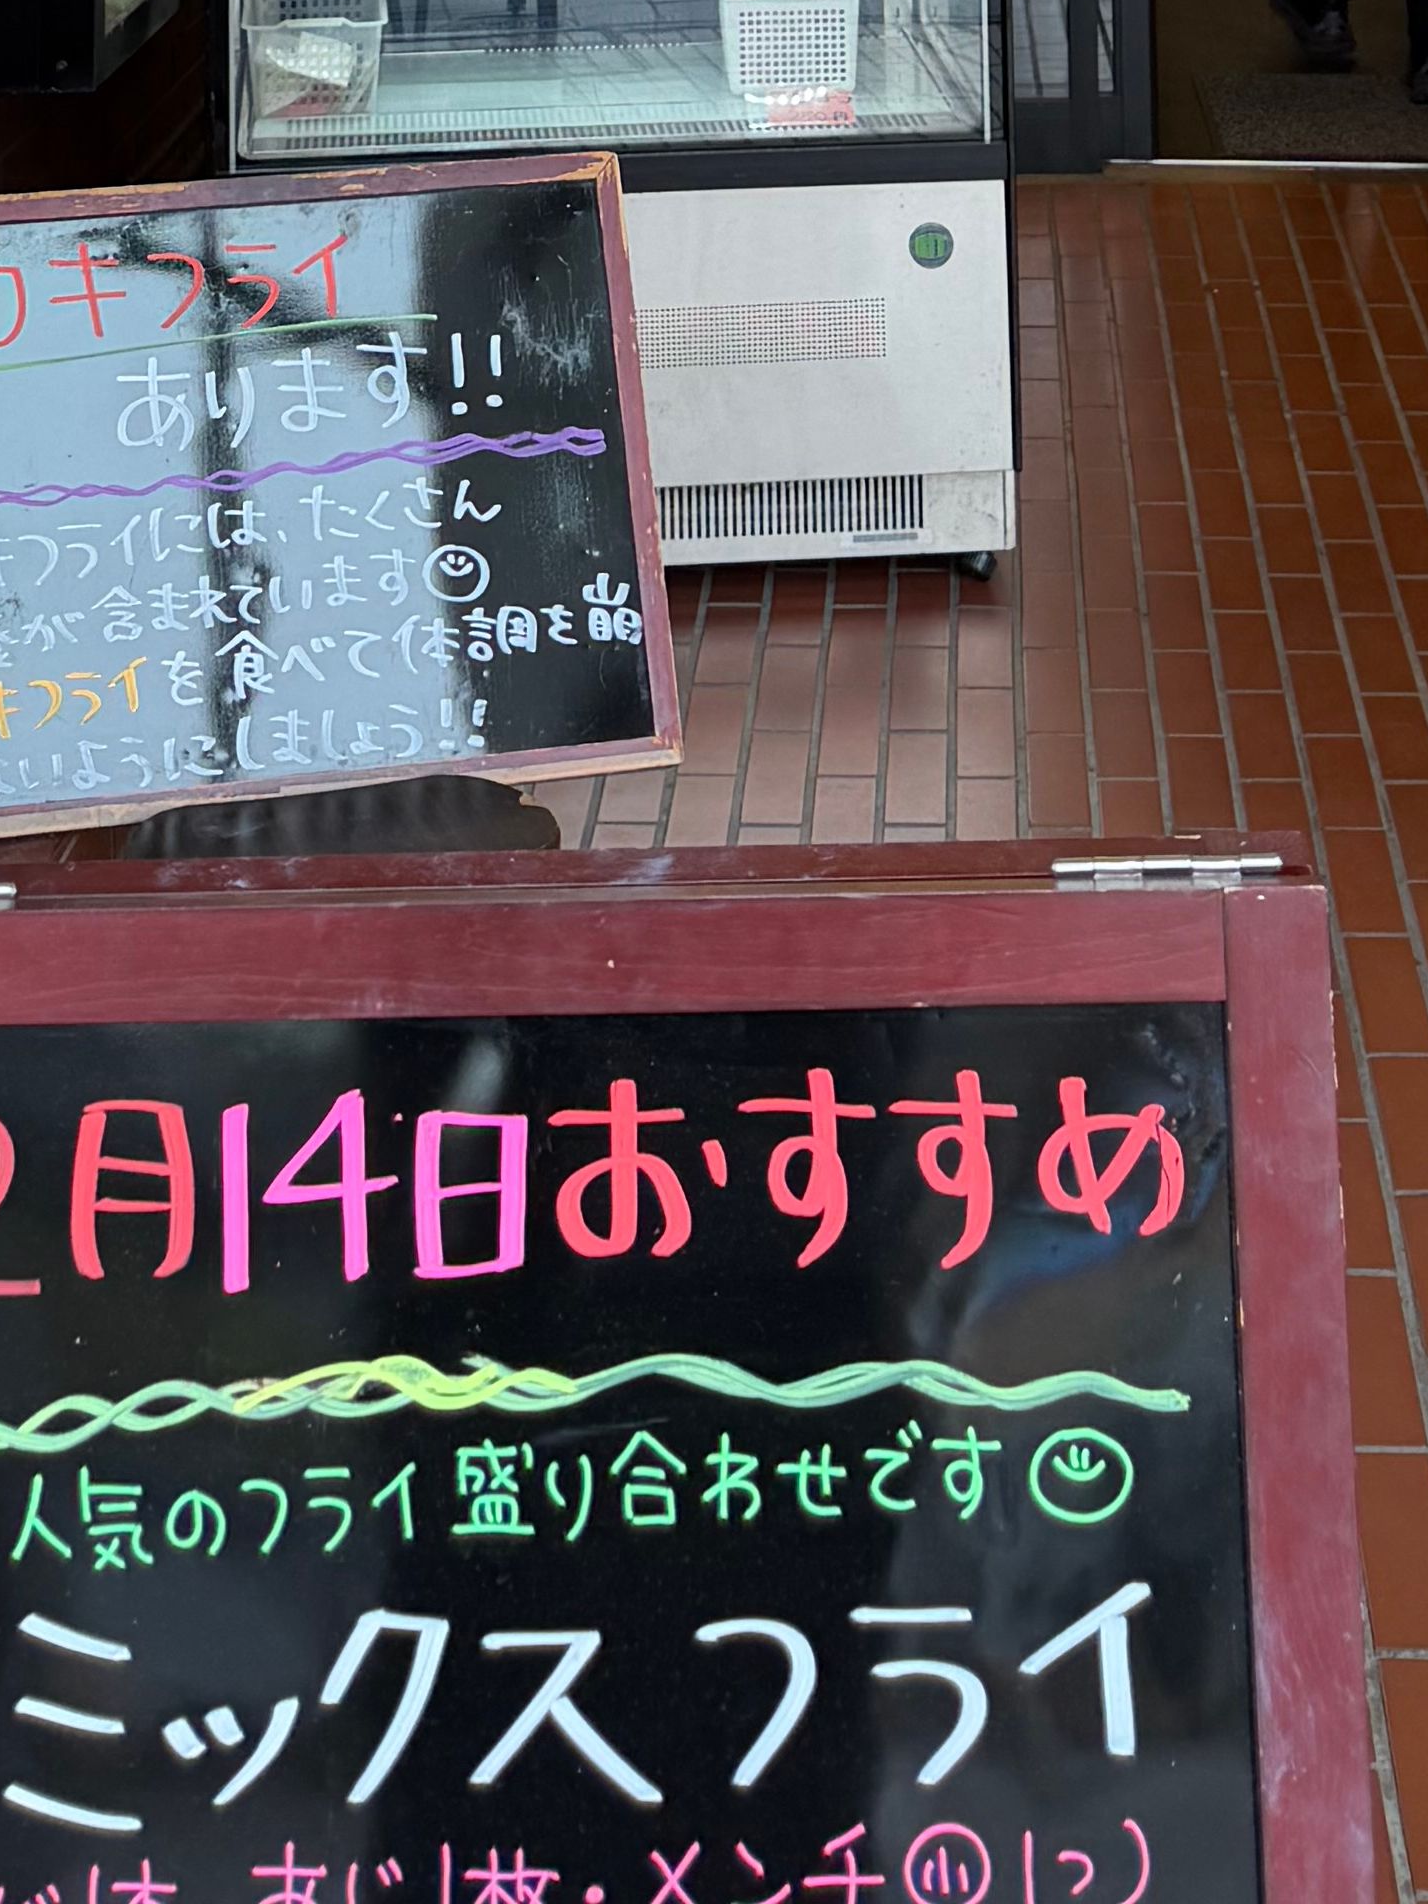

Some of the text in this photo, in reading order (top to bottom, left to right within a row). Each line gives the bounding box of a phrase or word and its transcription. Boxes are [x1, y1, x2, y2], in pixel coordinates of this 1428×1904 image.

[116, 330, 504, 453] あります!!
[8, 1420, 1006, 1575] 人気のフライ盛り合わせです
[2, 1578, 1156, 1835] ミックスフライ
